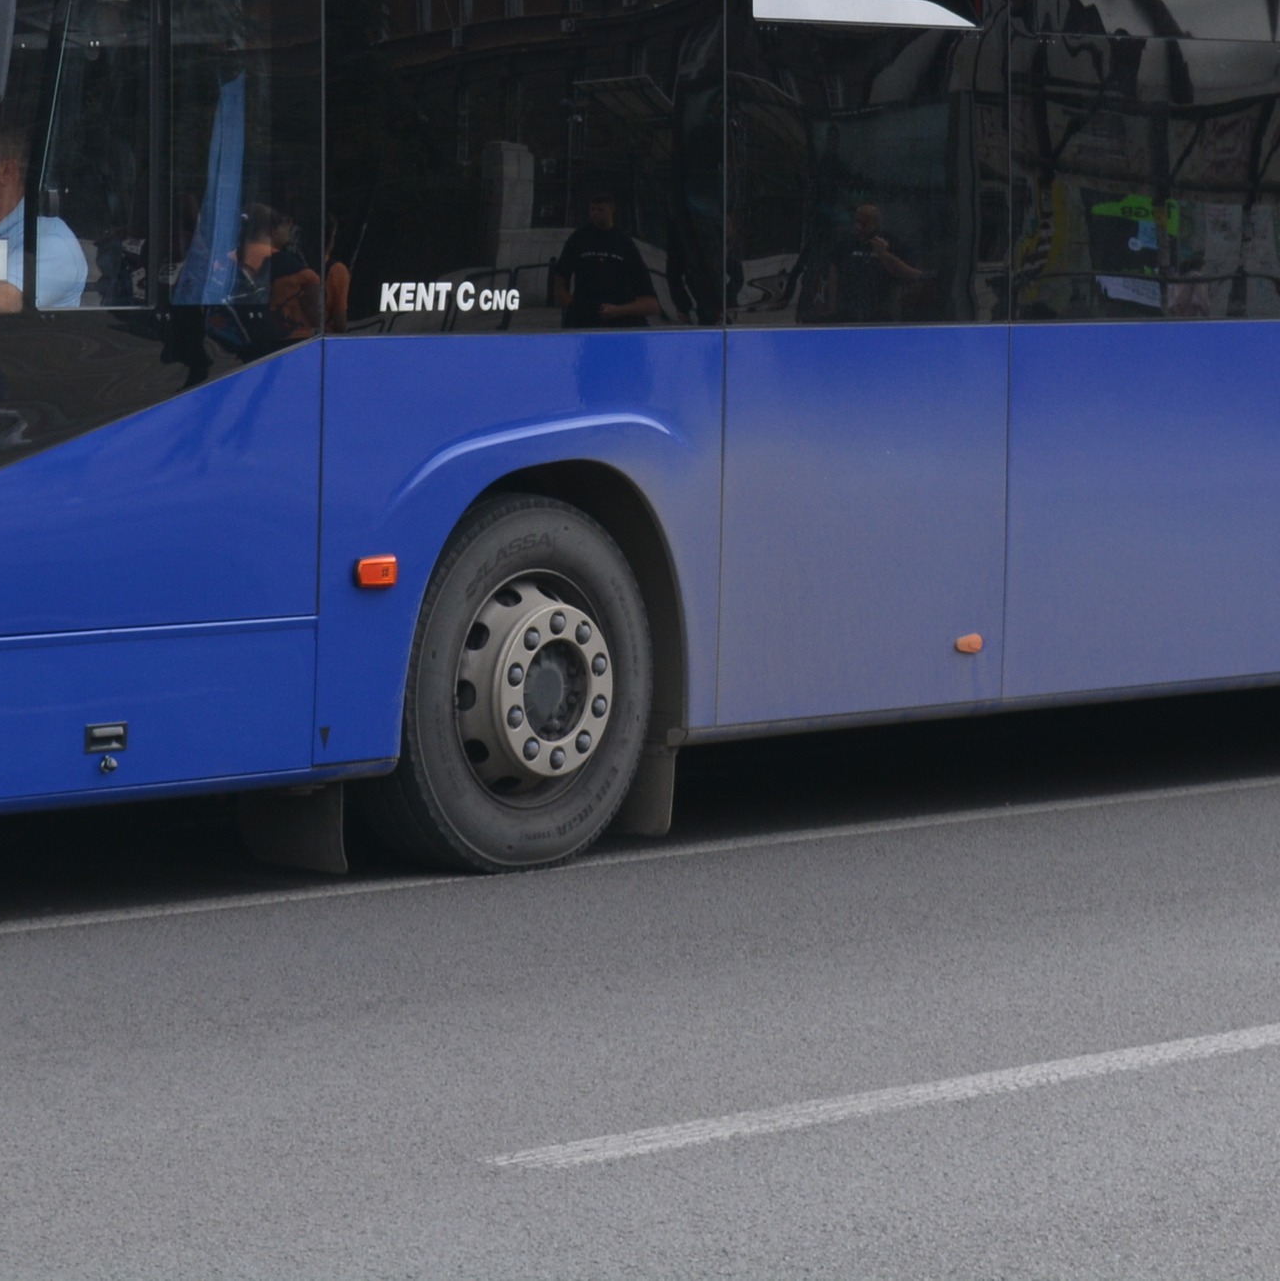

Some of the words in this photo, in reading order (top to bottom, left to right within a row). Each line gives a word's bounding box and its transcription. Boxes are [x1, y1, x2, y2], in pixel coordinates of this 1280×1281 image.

[379, 282, 452, 312] KENT
[456, 281, 475, 312] C
[479, 289, 520, 311] CNG
